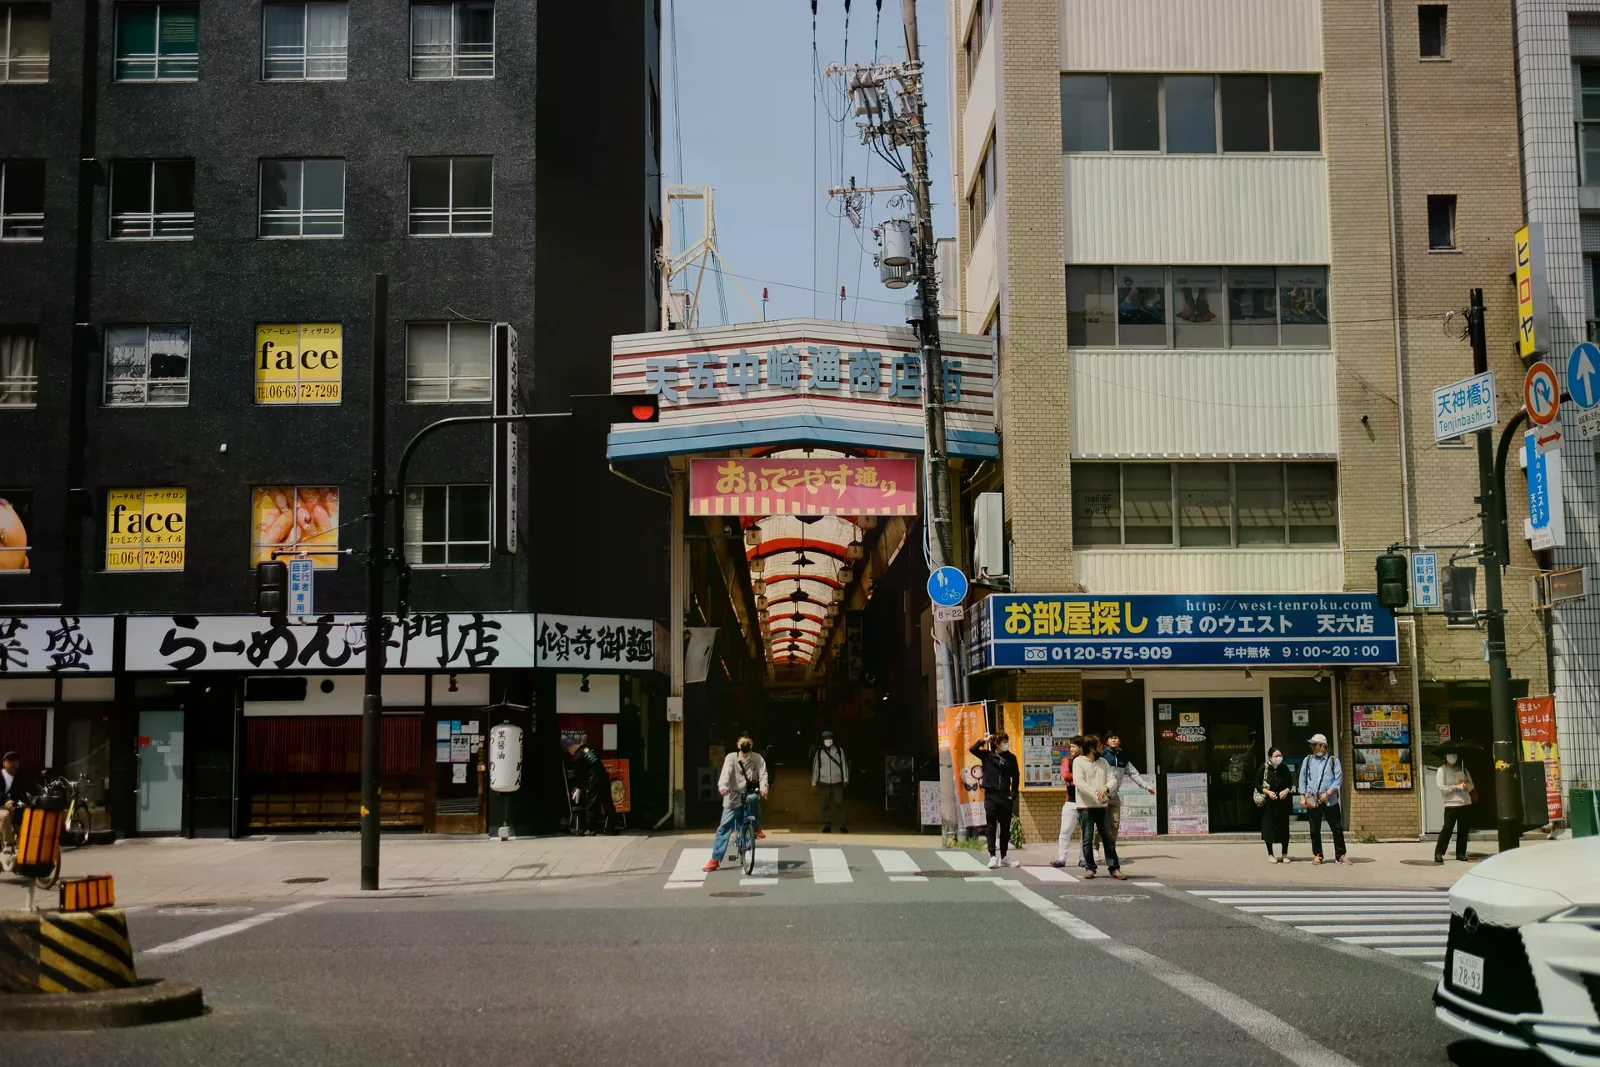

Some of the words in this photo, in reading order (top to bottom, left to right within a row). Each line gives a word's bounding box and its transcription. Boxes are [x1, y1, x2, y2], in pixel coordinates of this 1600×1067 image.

[1517, 241, 1533, 343] ヒロヤ
[258, 341, 339, 370] face
[257, 387, 269, 399] TEL
[269, 384, 339, 399] 06-6372-7299
[1437, 379, 1491, 418] 天神橋5
[1438, 405, 1492, 432] Tenjinbashi-5
[715, 460, 897, 500] おいでやす通り
[110, 504, 184, 534] face
[1416, 556, 1425, 583] 自転車
[1425, 556, 1434, 584] 歩行者
[1186, 599, 1373, 613] http://west-tenroku.com
[1422, 584, 1431, 603] 専用
[938, 609, 962, 619] 8-22
[1003, 601, 1149, 636] お部屋探し
[1316, 613, 1375, 634] 天六店
[159, 614, 502, 670] らーめん専門店
[1051, 646, 1172, 660] 0120-575-909
[1223, 646, 1271, 658] 年中無休
[1519, 703, 1541, 712] 住まい
[1458, 966, 1481, 990] 78-93
